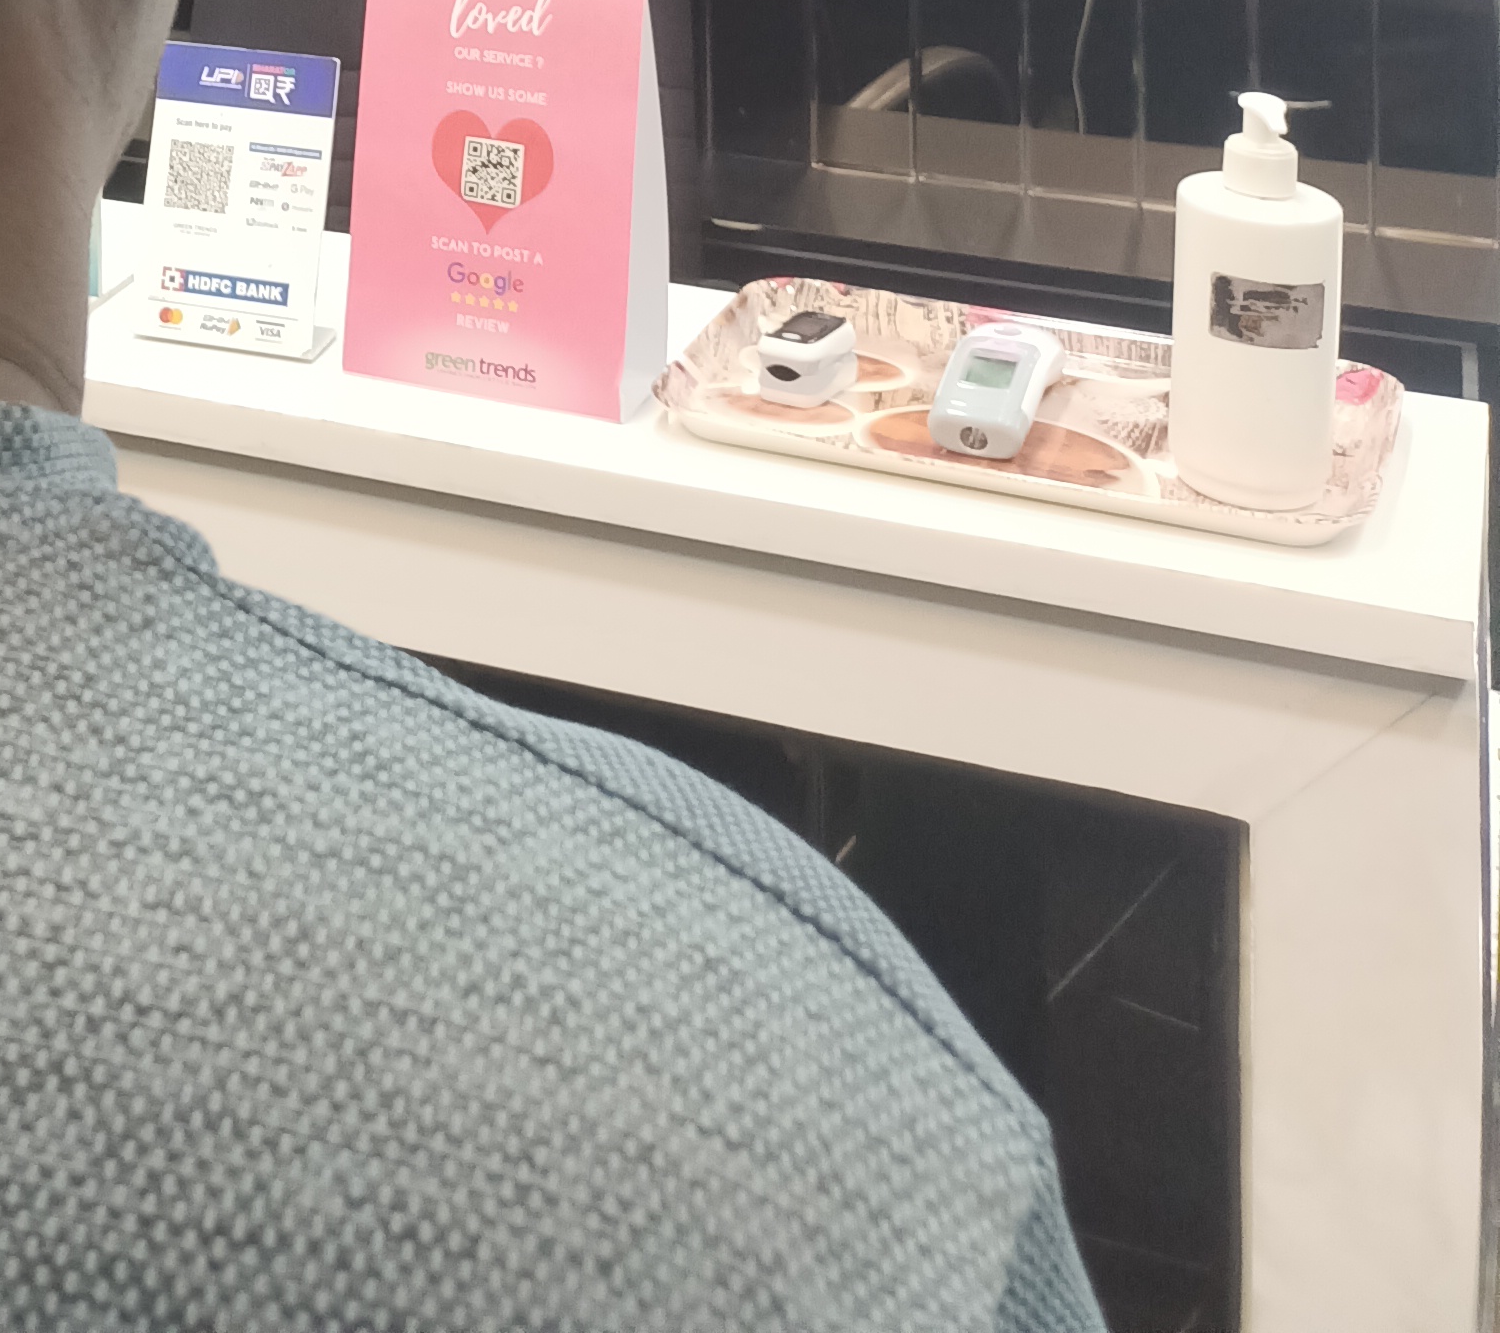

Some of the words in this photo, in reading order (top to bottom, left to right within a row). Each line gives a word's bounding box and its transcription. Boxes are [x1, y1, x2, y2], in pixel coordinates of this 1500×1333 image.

[454, 46, 481, 61] OUR
[482, 50, 534, 68] SERVICE
[200, 66, 241, 85] UPI
[446, 80, 486, 98] SHOW
[487, 86, 506, 101] US
[507, 88, 548, 106] SOME
[176, 117, 193, 127] Scan
[431, 236, 469, 254] SCAN
[471, 242, 492, 258] TO
[494, 245, 531, 263] POST
[533, 252, 544, 266] A
[187, 274, 232, 294] HDFC
[235, 281, 283, 302] BANK
[447, 261, 524, 296] Google
[259, 326, 281, 338] VISA
[456, 313, 510, 334] REVIEW
[425, 351, 476, 373] green
[479, 358, 537, 384] trends
